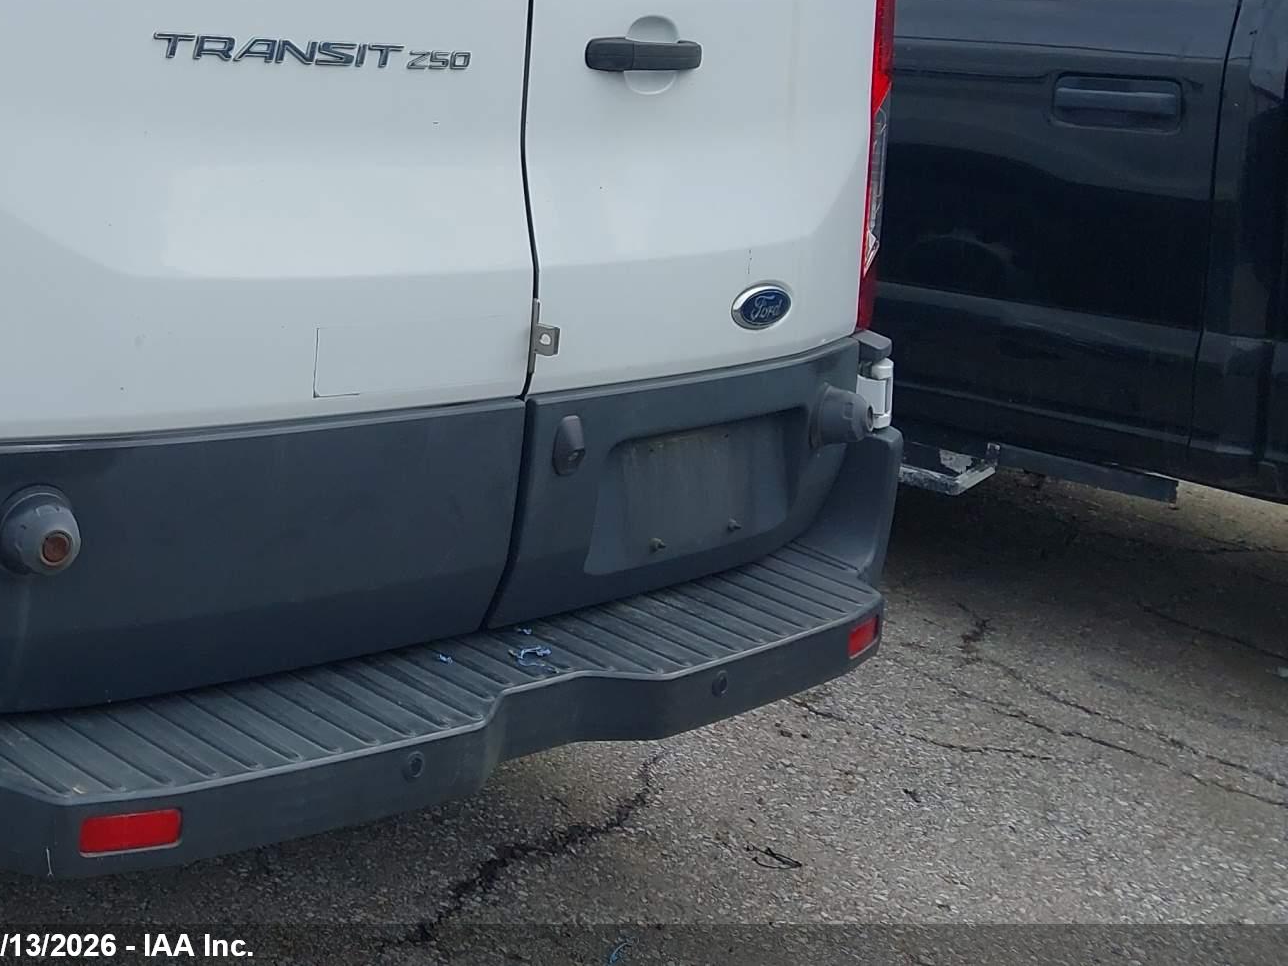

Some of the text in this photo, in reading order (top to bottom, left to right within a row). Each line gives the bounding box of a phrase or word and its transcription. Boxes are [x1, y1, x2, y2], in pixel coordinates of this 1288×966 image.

[153, 32, 471, 70] TRANSIT 250
[751, 295, 783, 321] Ford
